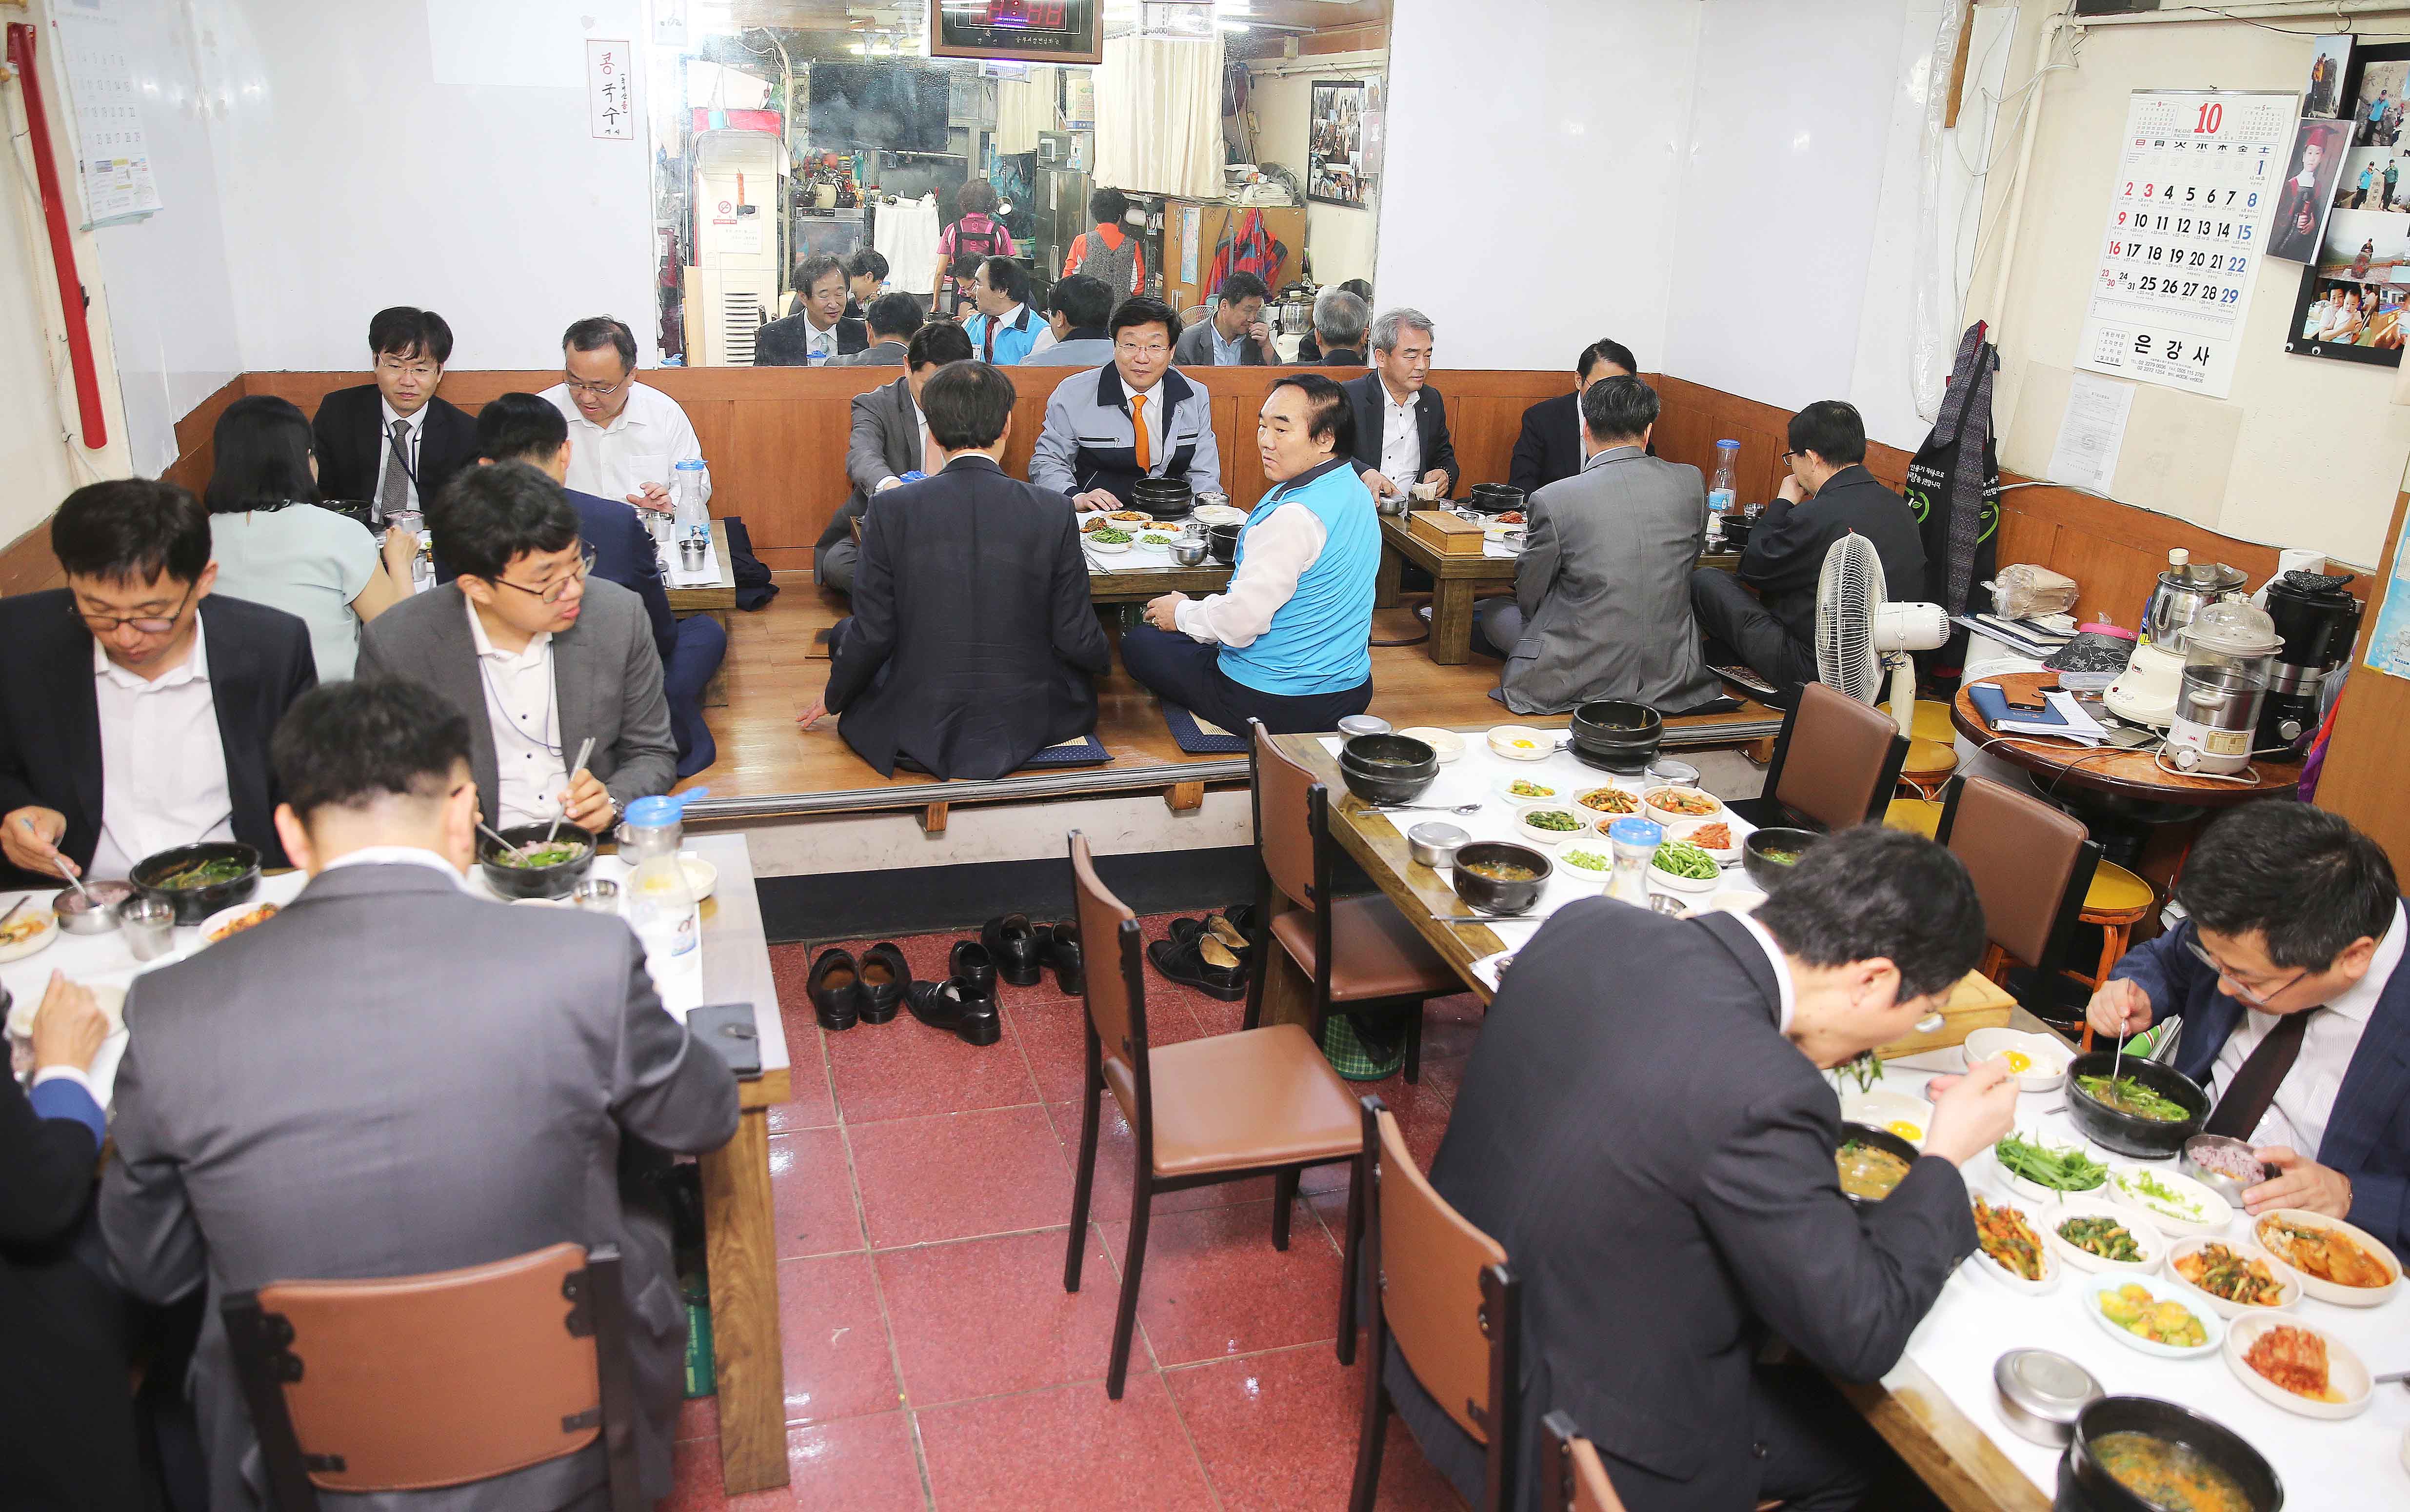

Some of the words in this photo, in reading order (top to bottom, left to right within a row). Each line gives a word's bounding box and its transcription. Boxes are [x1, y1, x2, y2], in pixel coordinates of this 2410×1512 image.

[2194, 103, 2223, 134] 10
[2257, 160, 2264, 175] 1
[2124, 181, 2133, 195] 2
[2144, 183, 2153, 197] 3
[2164, 185, 2173, 199] 4
[2186, 187, 2195, 201] 5
[2207, 189, 2216, 203] 6
[2226, 191, 2236, 205] 7
[2248, 193, 2257, 207] 8
[2117, 212, 2126, 225] 9
[2134, 213, 2147, 227] 10
[2157, 216, 2169, 230] 11
[2177, 218, 2191, 233] 12
[2198, 220, 2210, 235] 13
[2218, 222, 2231, 238] 14
[2237, 224, 2252, 240] 15
[2109, 241, 2120, 255] 16
[2127, 243, 2142, 257] 17
[2148, 246, 2162, 260] 18
[2170, 249, 2184, 263] 19
[2189, 252, 2205, 266] 20
[2210, 255, 2223, 269] 21
[2228, 257, 2246, 272] 22
[2139, 277, 2157, 290] 25
[2162, 279, 2177, 294] 26
[2182, 282, 2199, 297] 27
[2201, 285, 2217, 299] 28
[2221, 288, 2238, 303] 29
